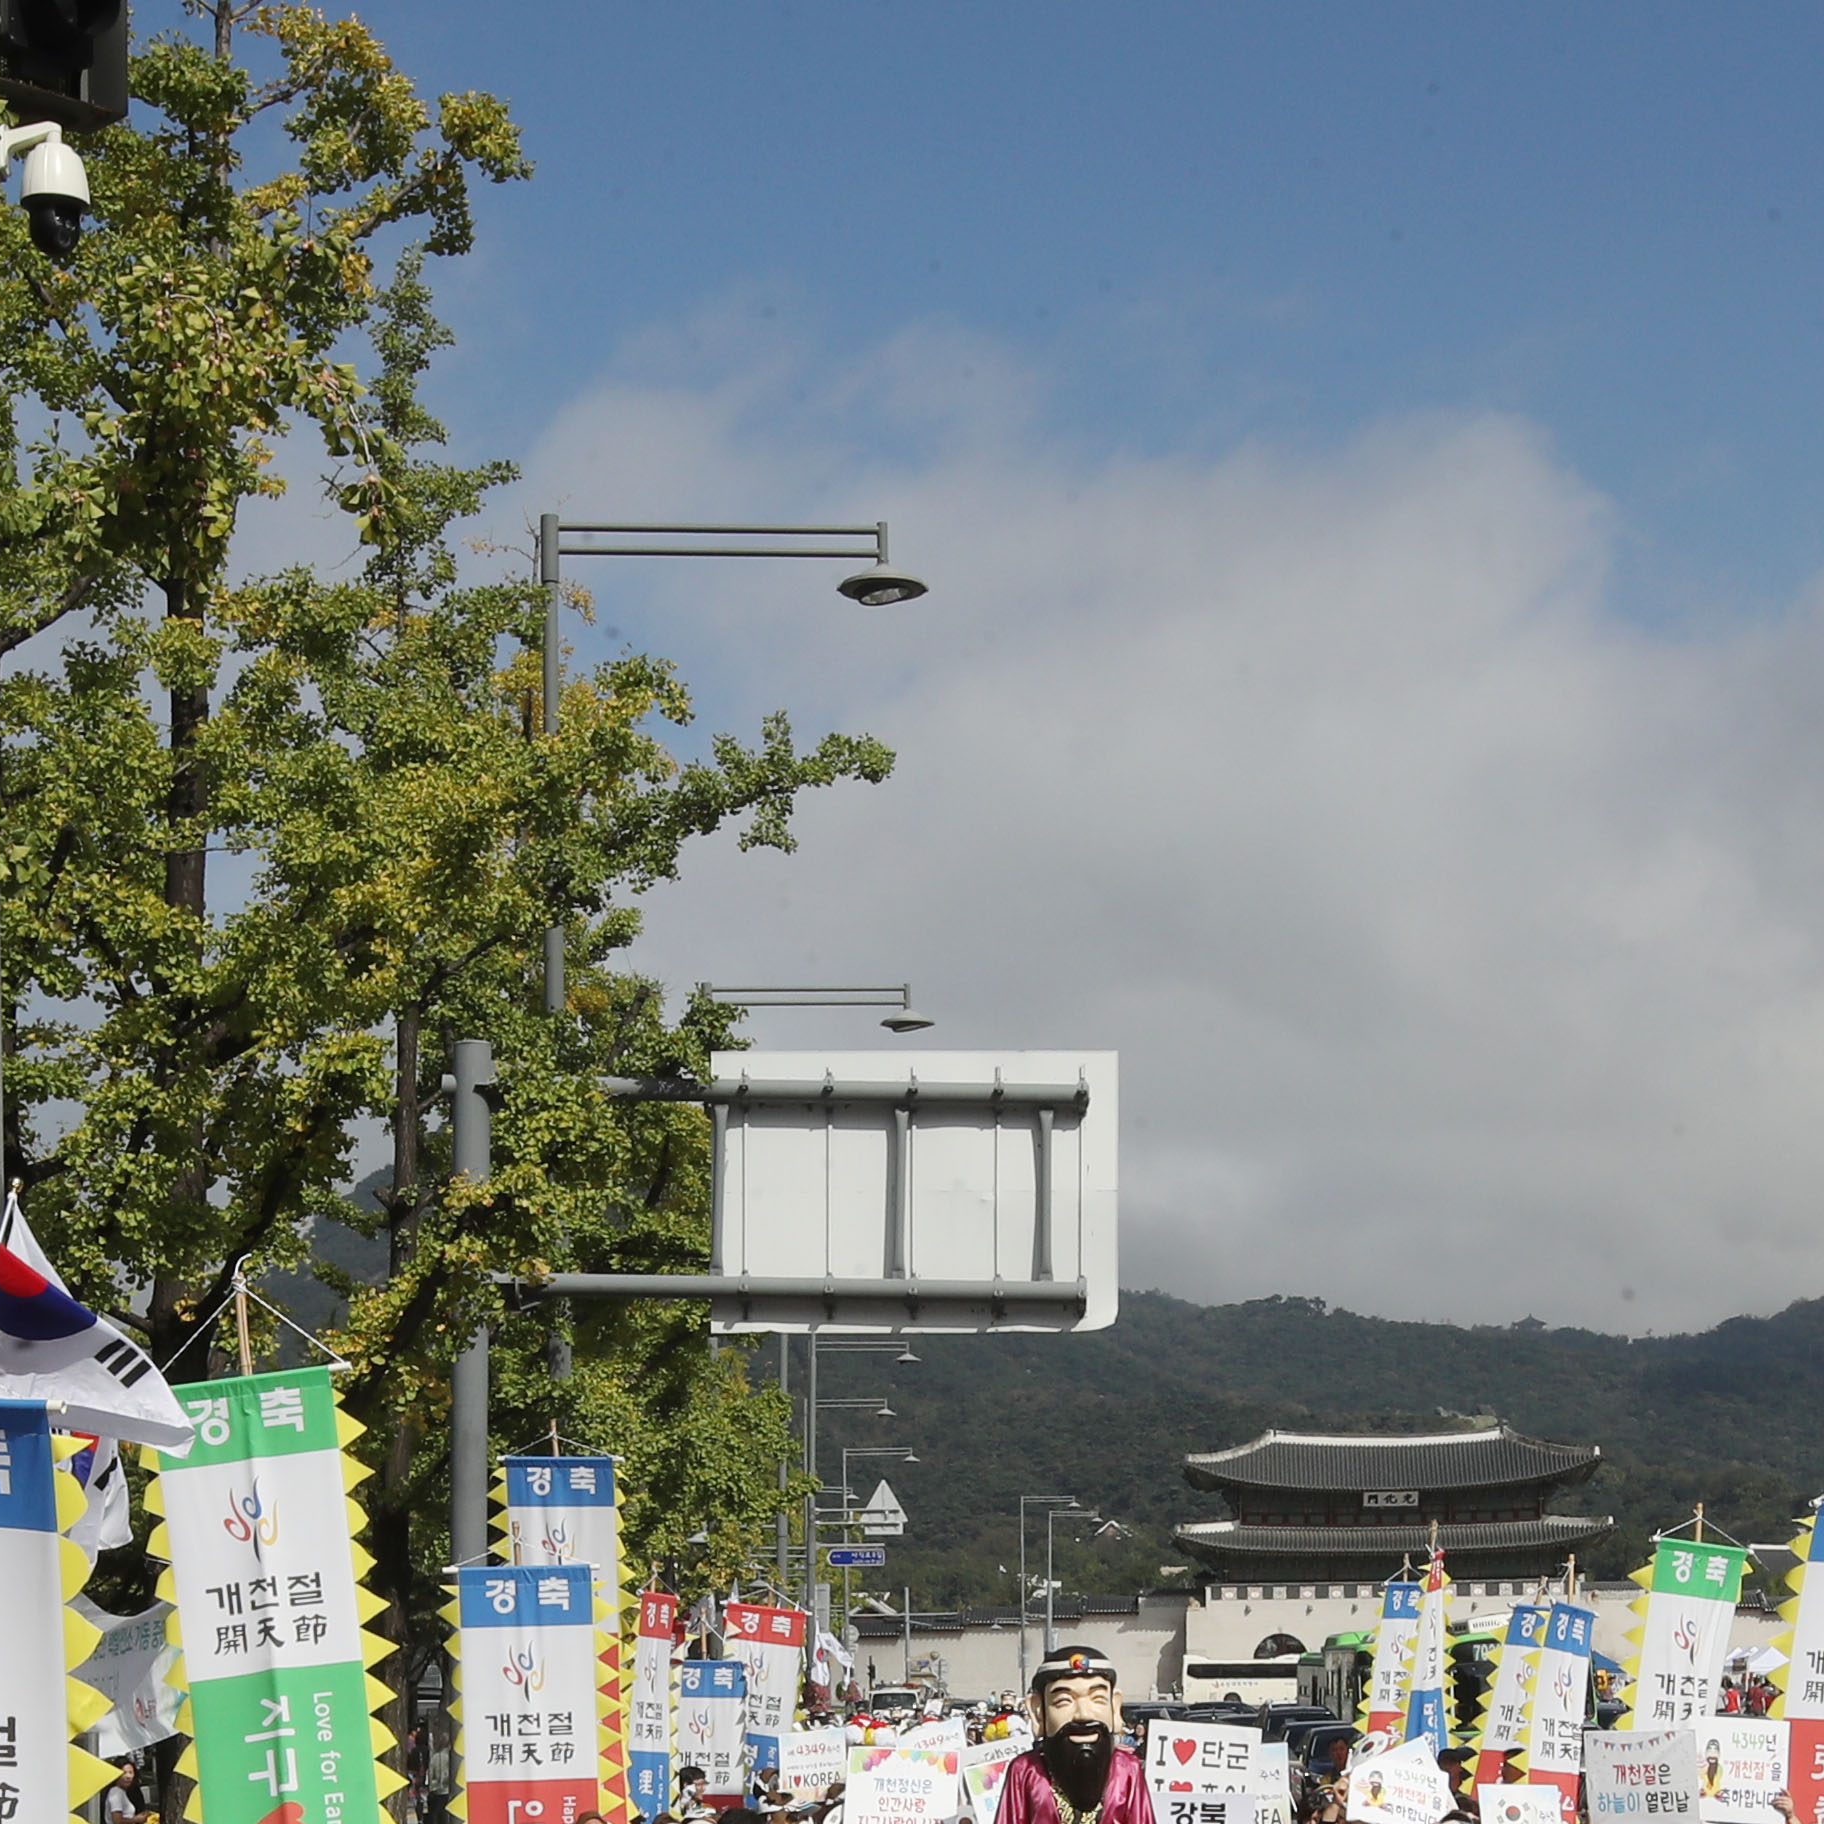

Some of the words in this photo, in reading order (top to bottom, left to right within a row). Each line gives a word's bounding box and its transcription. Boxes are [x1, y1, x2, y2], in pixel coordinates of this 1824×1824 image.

[205, 1571, 324, 1616] 개천절
[214, 1613, 328, 1656] 開天節
[313, 1691, 333, 1742] Love
[484, 1711, 574, 1737] 개천절
[486, 1741, 575, 1766] 開天節
[1201, 1740, 1251, 1770] 단군
[1732, 1732, 1777, 1753] 4349년
[320, 1750, 341, 1783] for
[679, 1751, 730, 1768] 개천절
[803, 1771, 841, 1788] KOREA
[873, 1778, 934, 1795] 개천정신은
[1613, 1763, 1672, 1786] 개천절은
[878, 1798, 927, 1814] 인간사랑
[1597, 1791, 1641, 1815] 하늘이
[1645, 1790, 1690, 1814] 열린날
